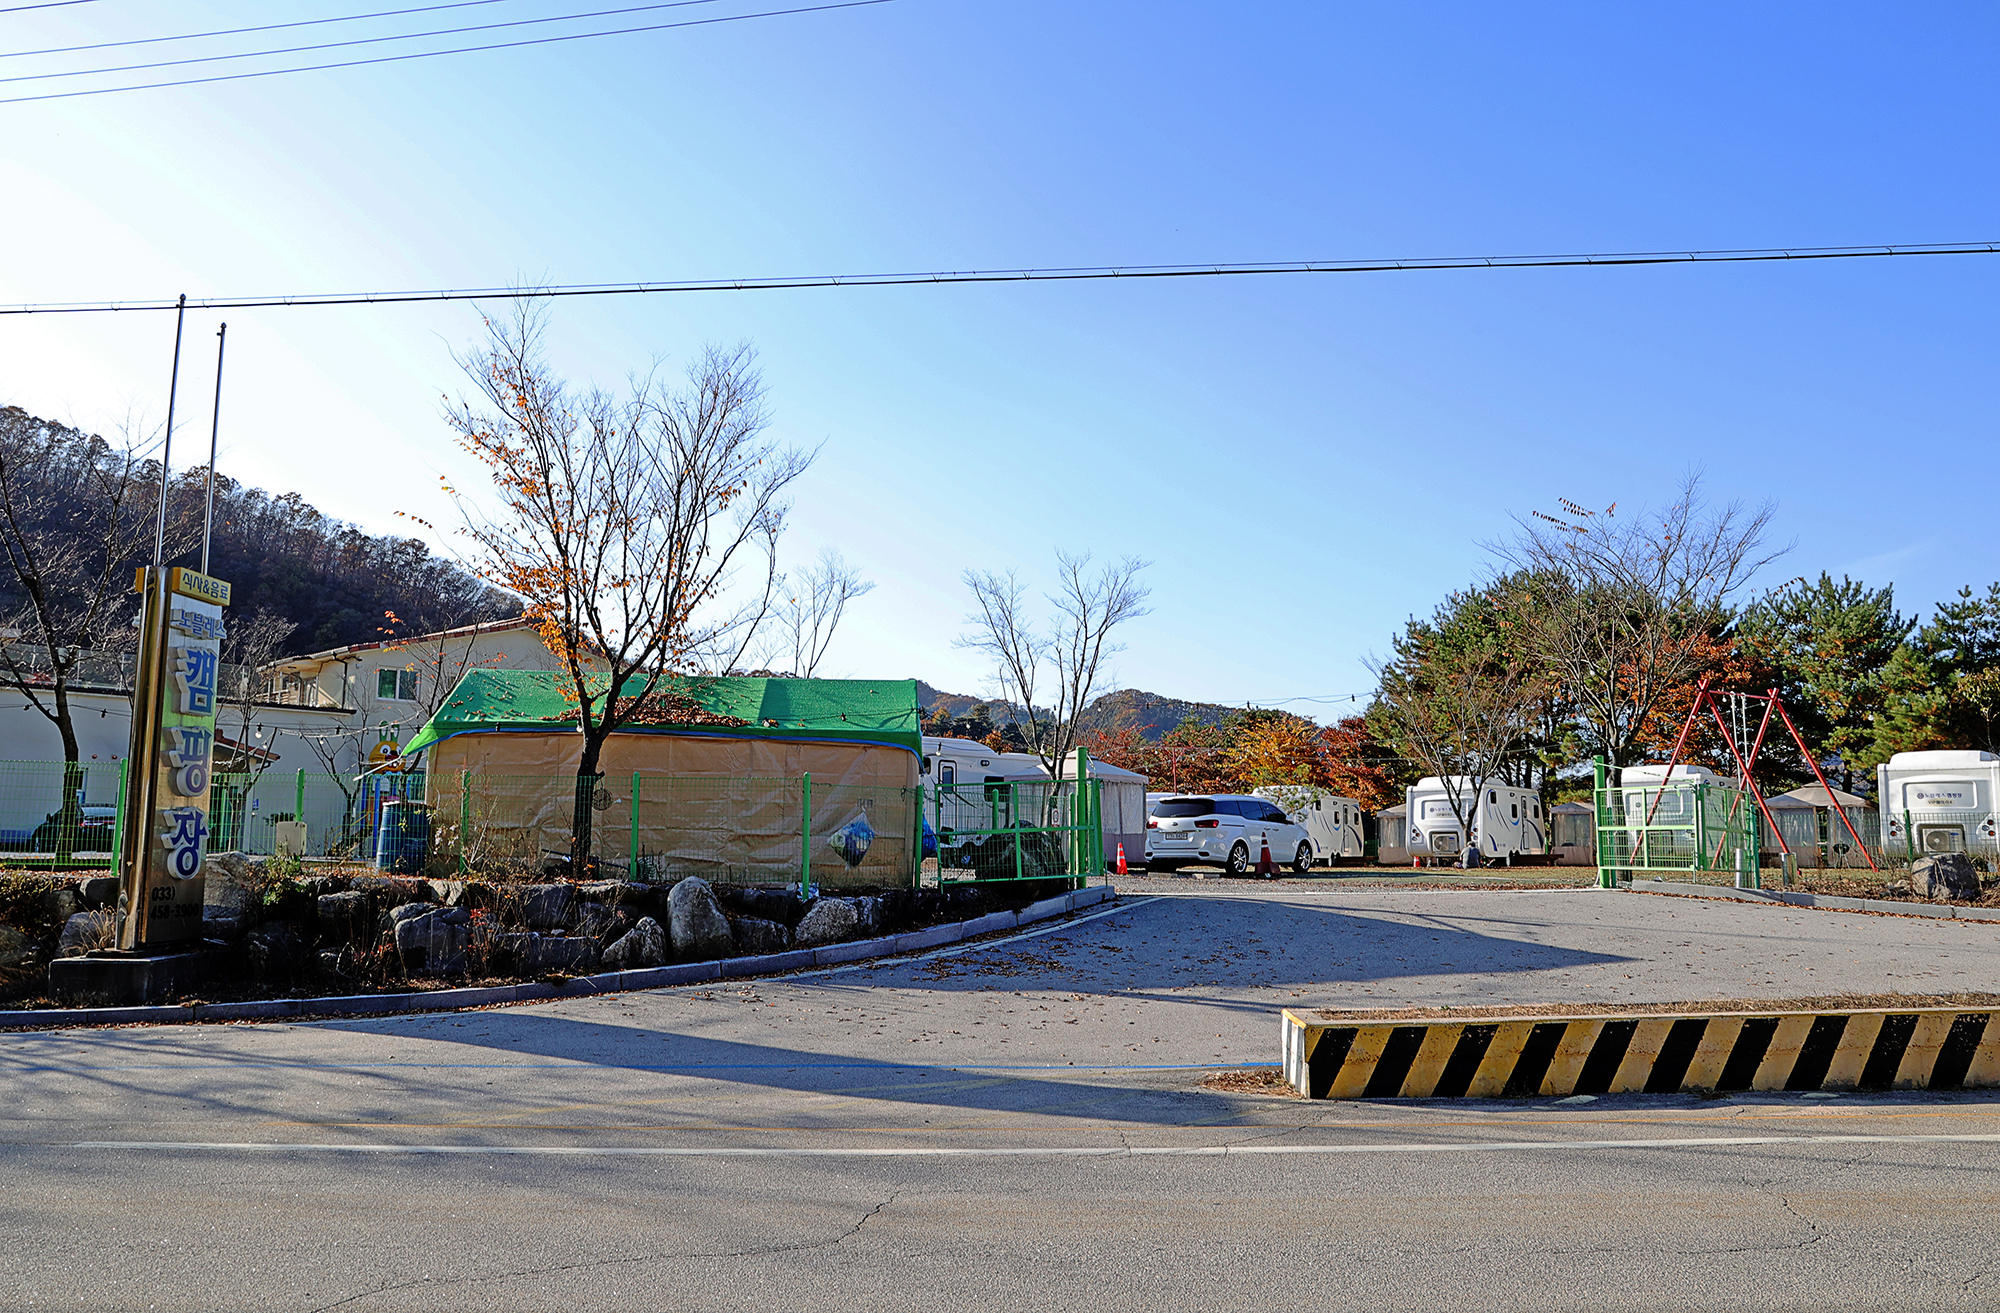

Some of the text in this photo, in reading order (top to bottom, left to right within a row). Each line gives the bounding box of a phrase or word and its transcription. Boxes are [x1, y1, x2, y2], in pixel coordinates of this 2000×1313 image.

[182, 572, 229, 600] 식사&음료
[178, 609, 227, 639] 노블레스
[170, 649, 217, 879] 캠핑장
[151, 885, 176, 902] 033)
